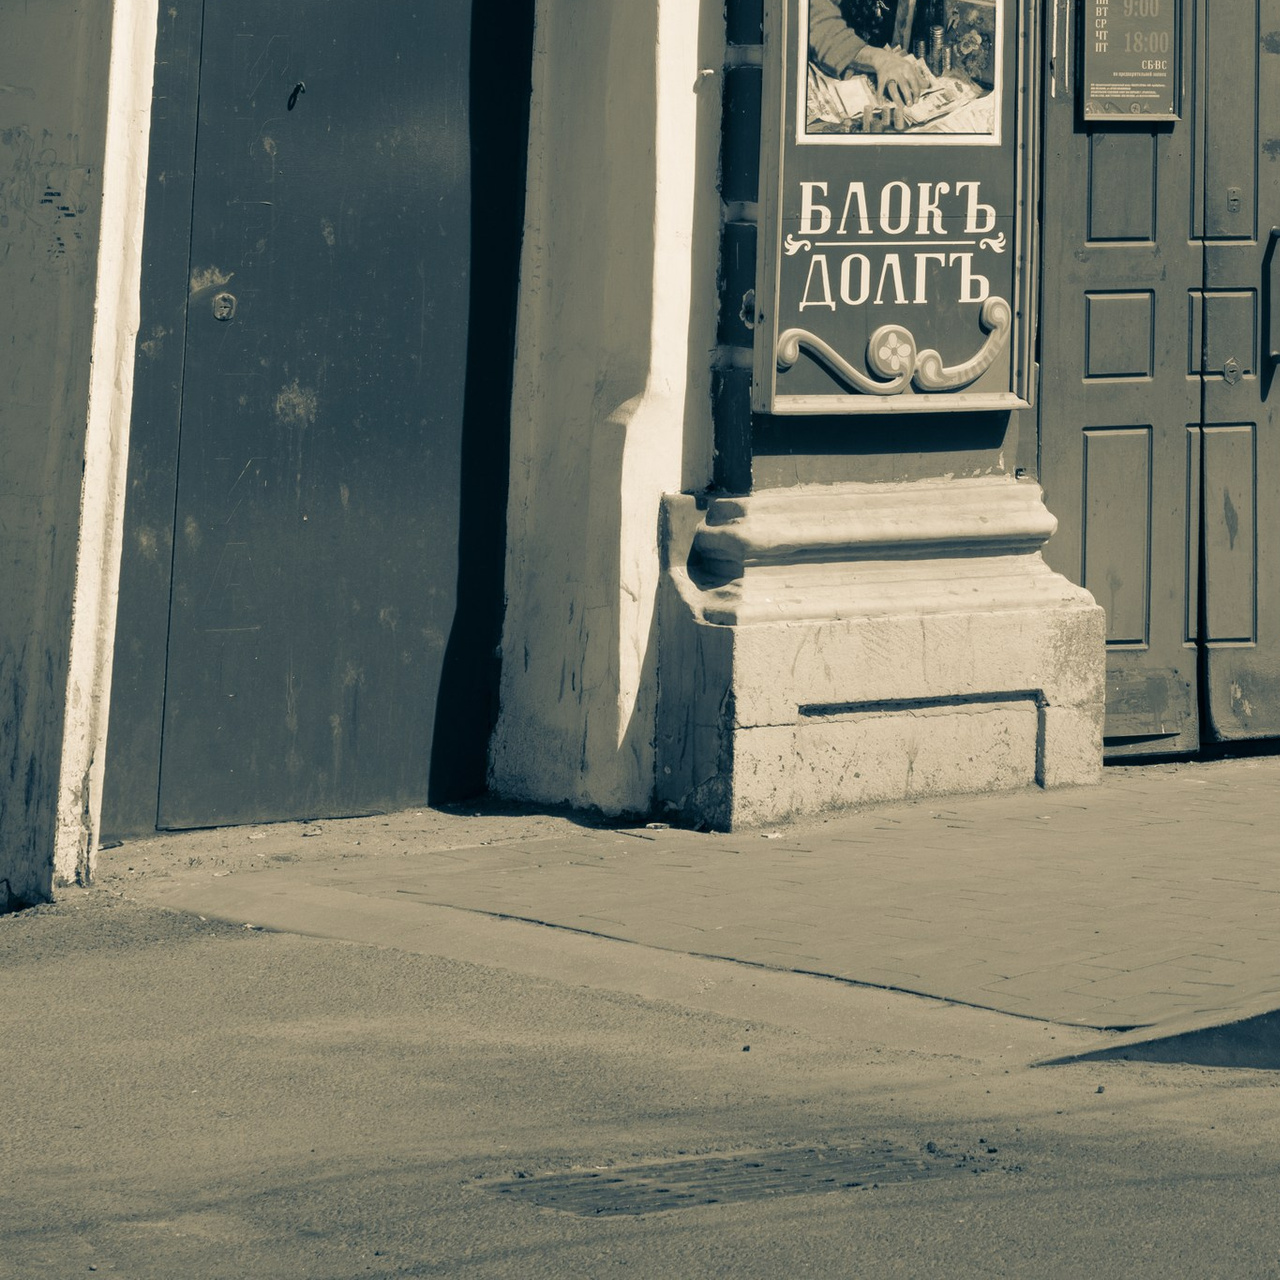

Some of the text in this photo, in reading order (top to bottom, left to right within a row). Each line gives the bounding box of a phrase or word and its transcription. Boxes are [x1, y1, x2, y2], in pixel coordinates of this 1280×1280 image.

[1095, 6, 1108, 17] ВТ
[1095, 19, 1107, 28] СР
[1095, 30, 1108, 40] ЧТ
[1095, 42, 1108, 52] ПТ
[1124, 31, 1169, 53] 18:00
[798, 181, 997, 235] БЛОКЪ
[798, 252, 990, 312] ДОЛГЪ
